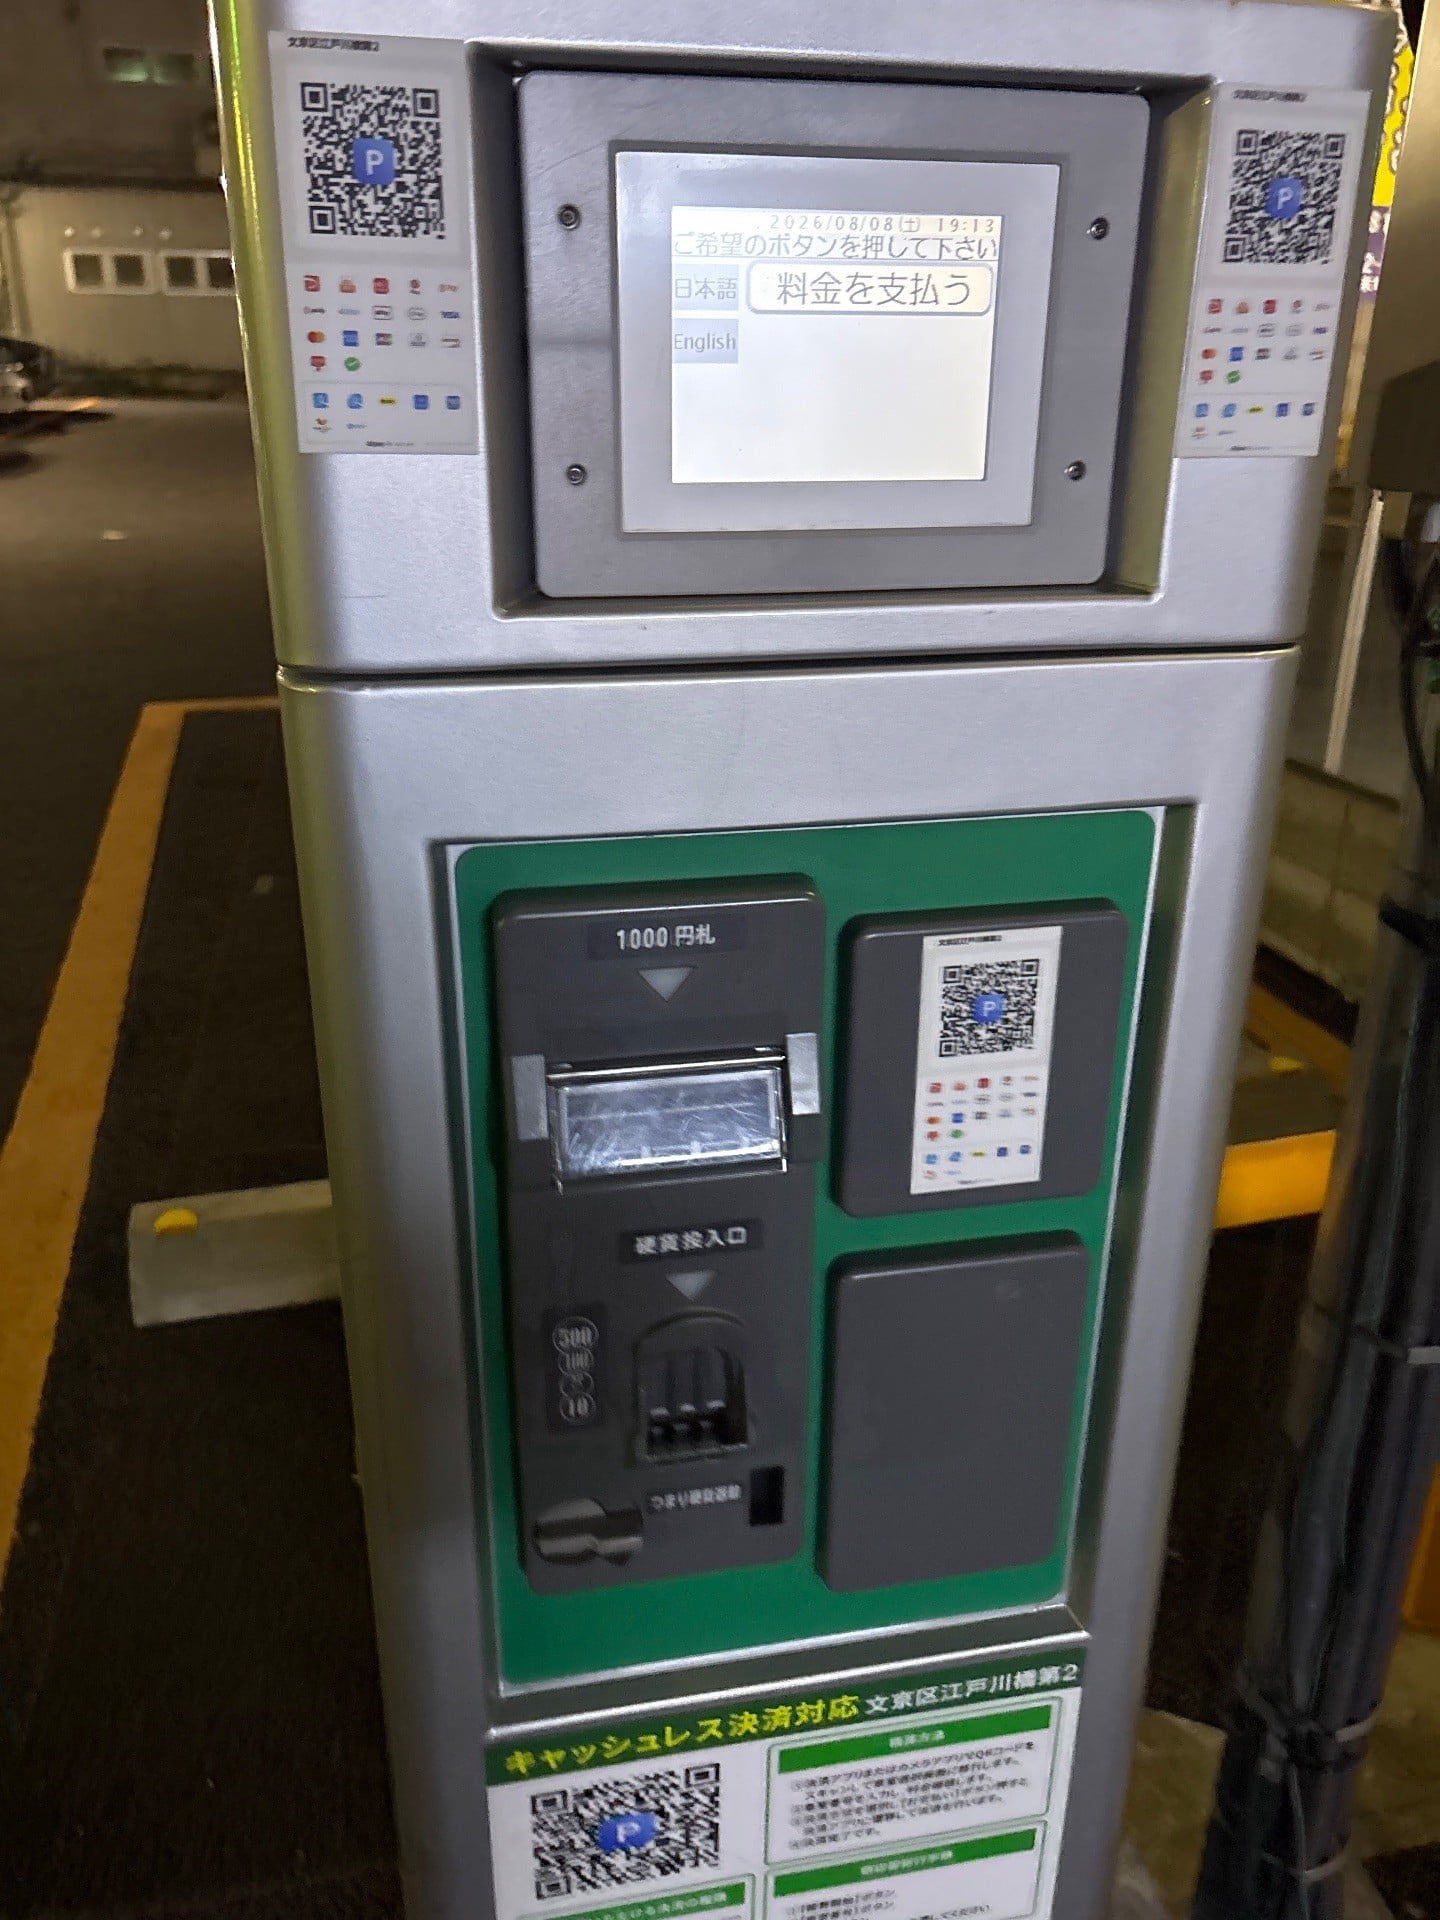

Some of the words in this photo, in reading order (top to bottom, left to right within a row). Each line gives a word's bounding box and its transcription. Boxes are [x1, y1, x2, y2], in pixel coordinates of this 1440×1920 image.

[366, 148, 384, 176] P
[1276, 186, 1294, 210] P
[937, 218, 995, 233] 19:13
[673, 231, 998, 260] ご希望のボタンを押して下さい
[674, 277, 738, 300] 日本語
[776, 271, 971, 306] 料金を支払う
[673, 332, 737, 353] English
[616, 927, 669, 950] 1000
[675, 924, 716, 947] 円札
[982, 1000, 997, 1017] P
[505, 1695, 860, 1776] キャッシュレス決済対応
[864, 1663, 1079, 1715] 文京区江戸川橋第2
[617, 1821, 640, 1844] P
